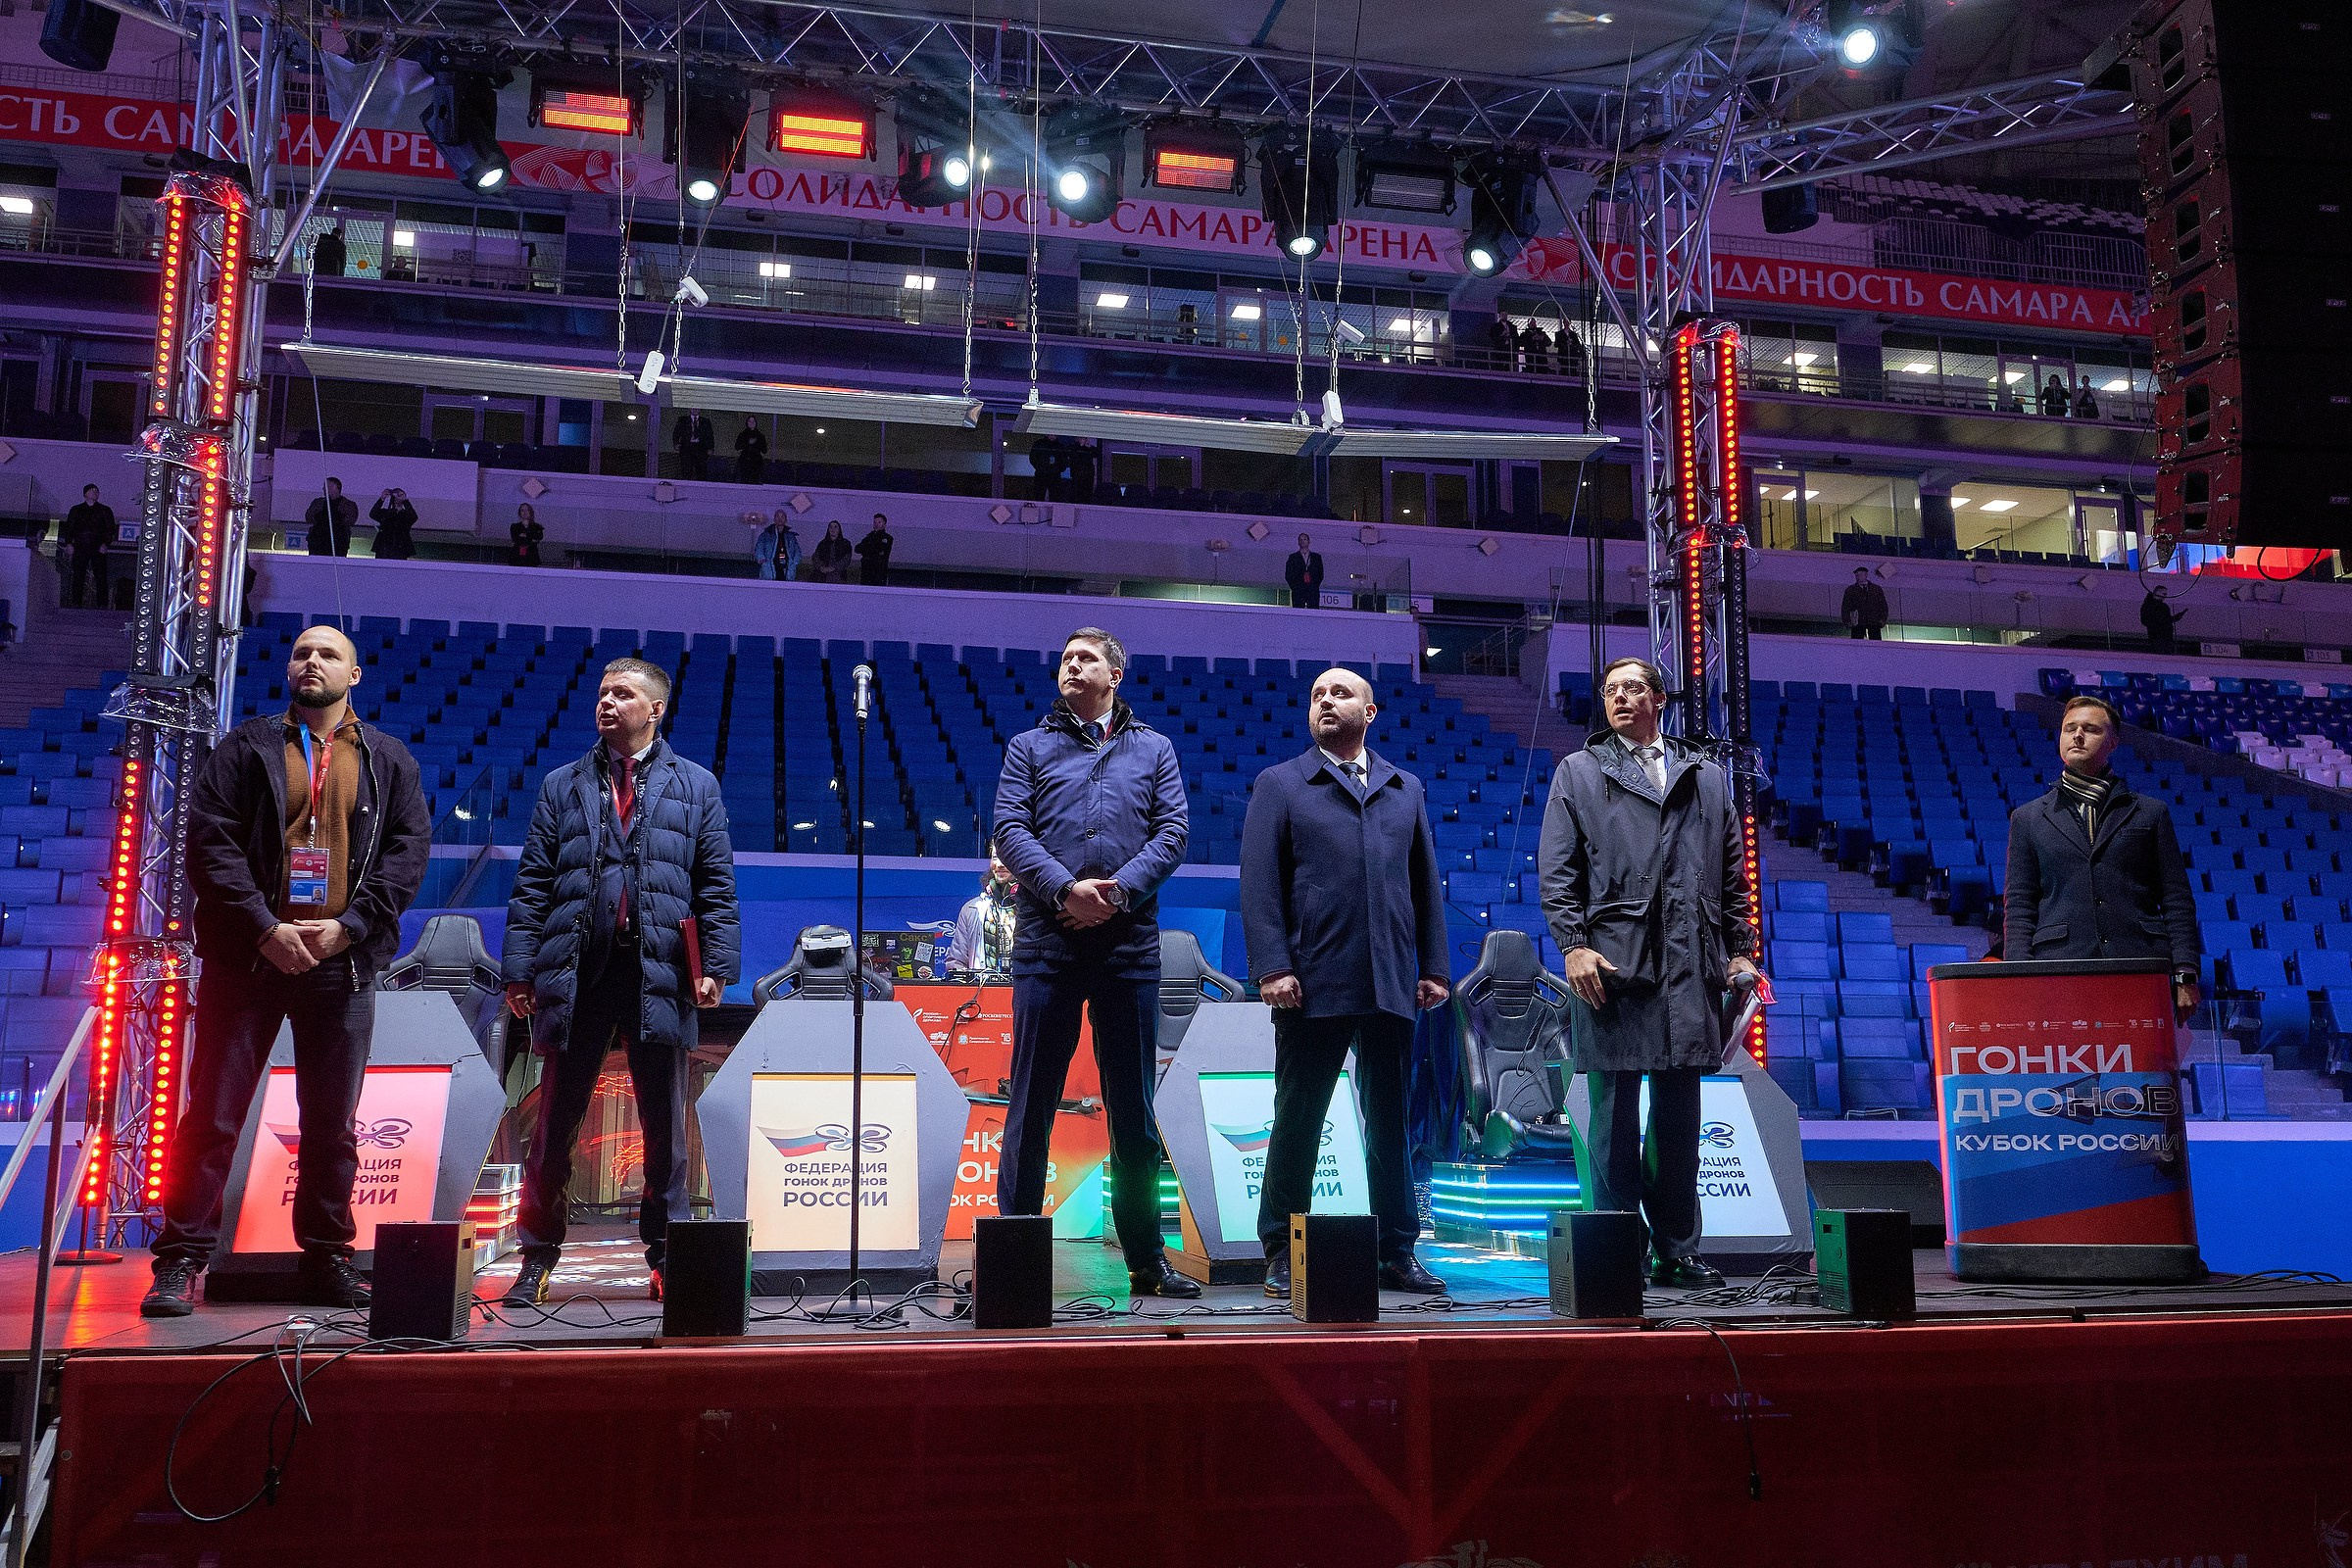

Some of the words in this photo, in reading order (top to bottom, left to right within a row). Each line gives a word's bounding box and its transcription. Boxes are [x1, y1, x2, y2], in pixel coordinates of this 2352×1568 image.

[1939, 281, 2093, 324] САМАРА
[1322, 596, 1339, 606] 106
[1950, 1044, 2133, 1075] ГОНКИ
[1952, 1085, 2179, 1123] ДРОНОВ
[1955, 1134, 2053, 1152] КУБОК
[2058, 1134, 2180, 1152] РОССИИ
[784, 1177, 829, 1186] ГОНОК
